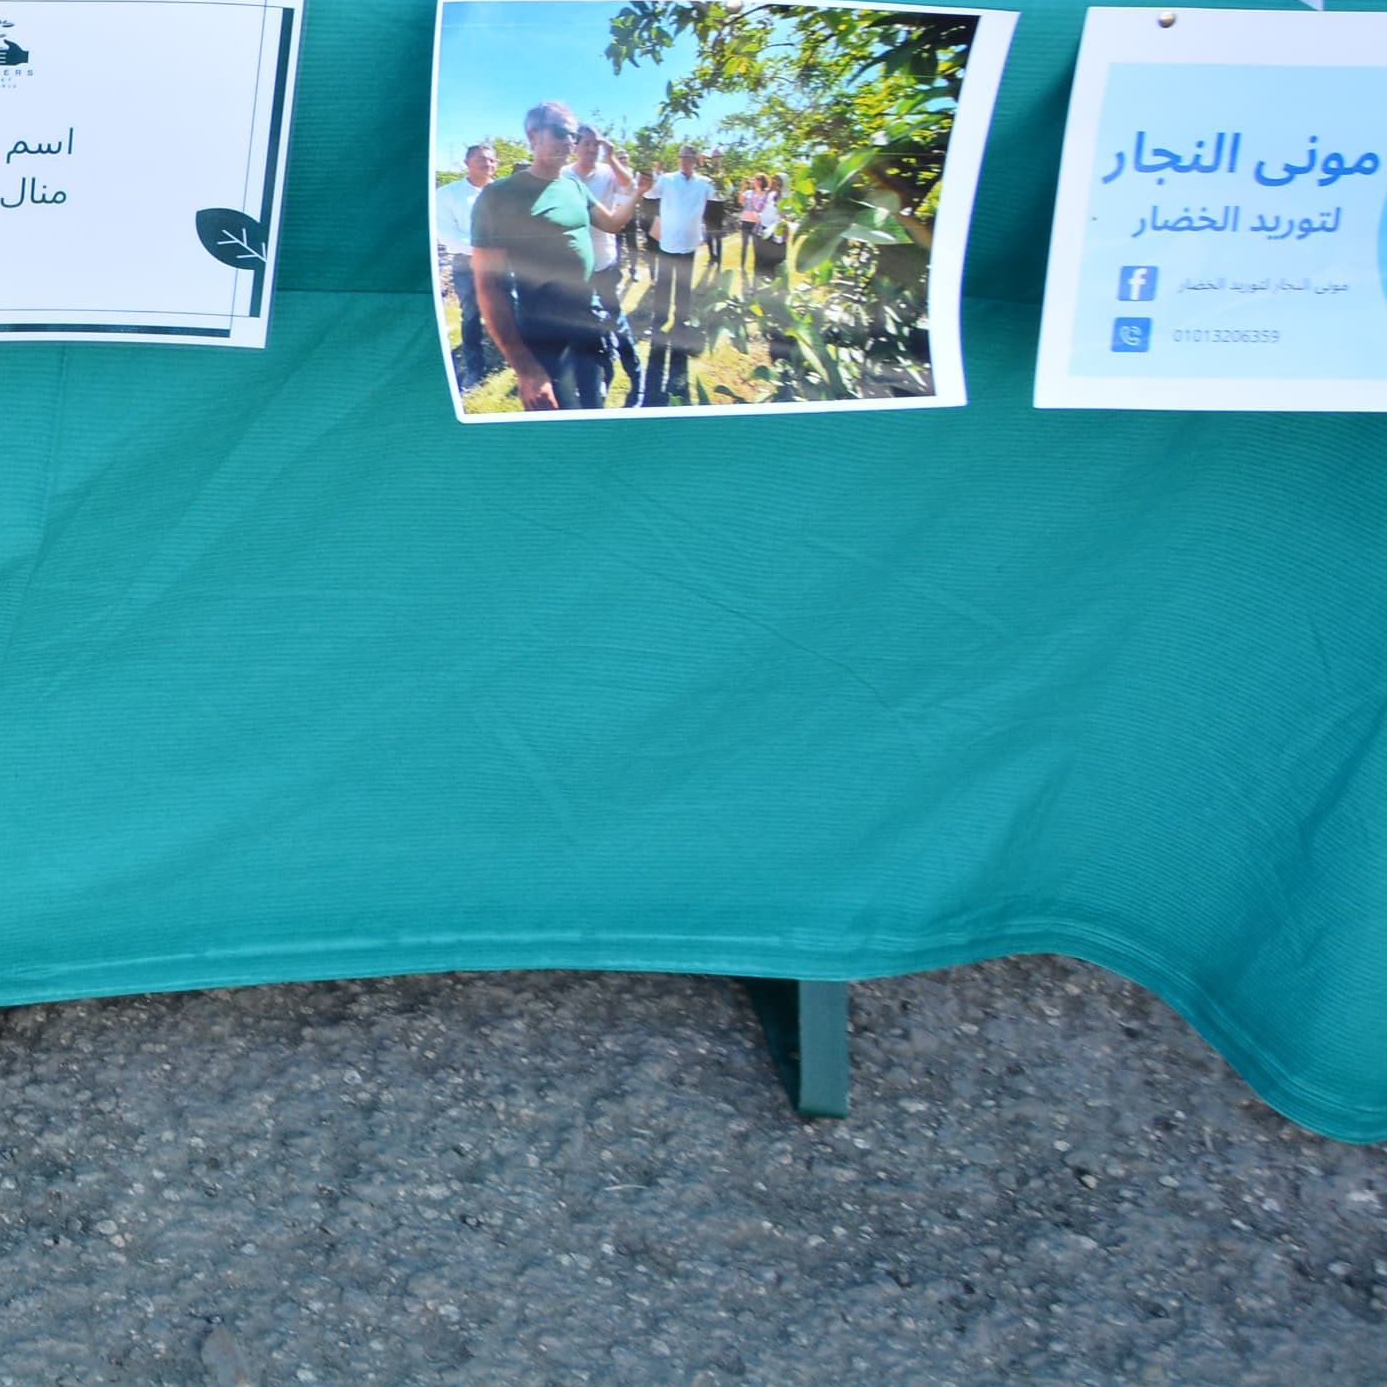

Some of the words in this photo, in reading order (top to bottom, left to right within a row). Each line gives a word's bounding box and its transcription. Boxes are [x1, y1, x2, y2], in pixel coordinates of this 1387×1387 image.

[6, 126, 74, 164] اسم
[1101, 130, 1242, 185] النجار
[0, 176, 67, 209] منال
[1131, 205, 1240, 238] الخضار
[1249, 206, 1343, 241] لتوريد
